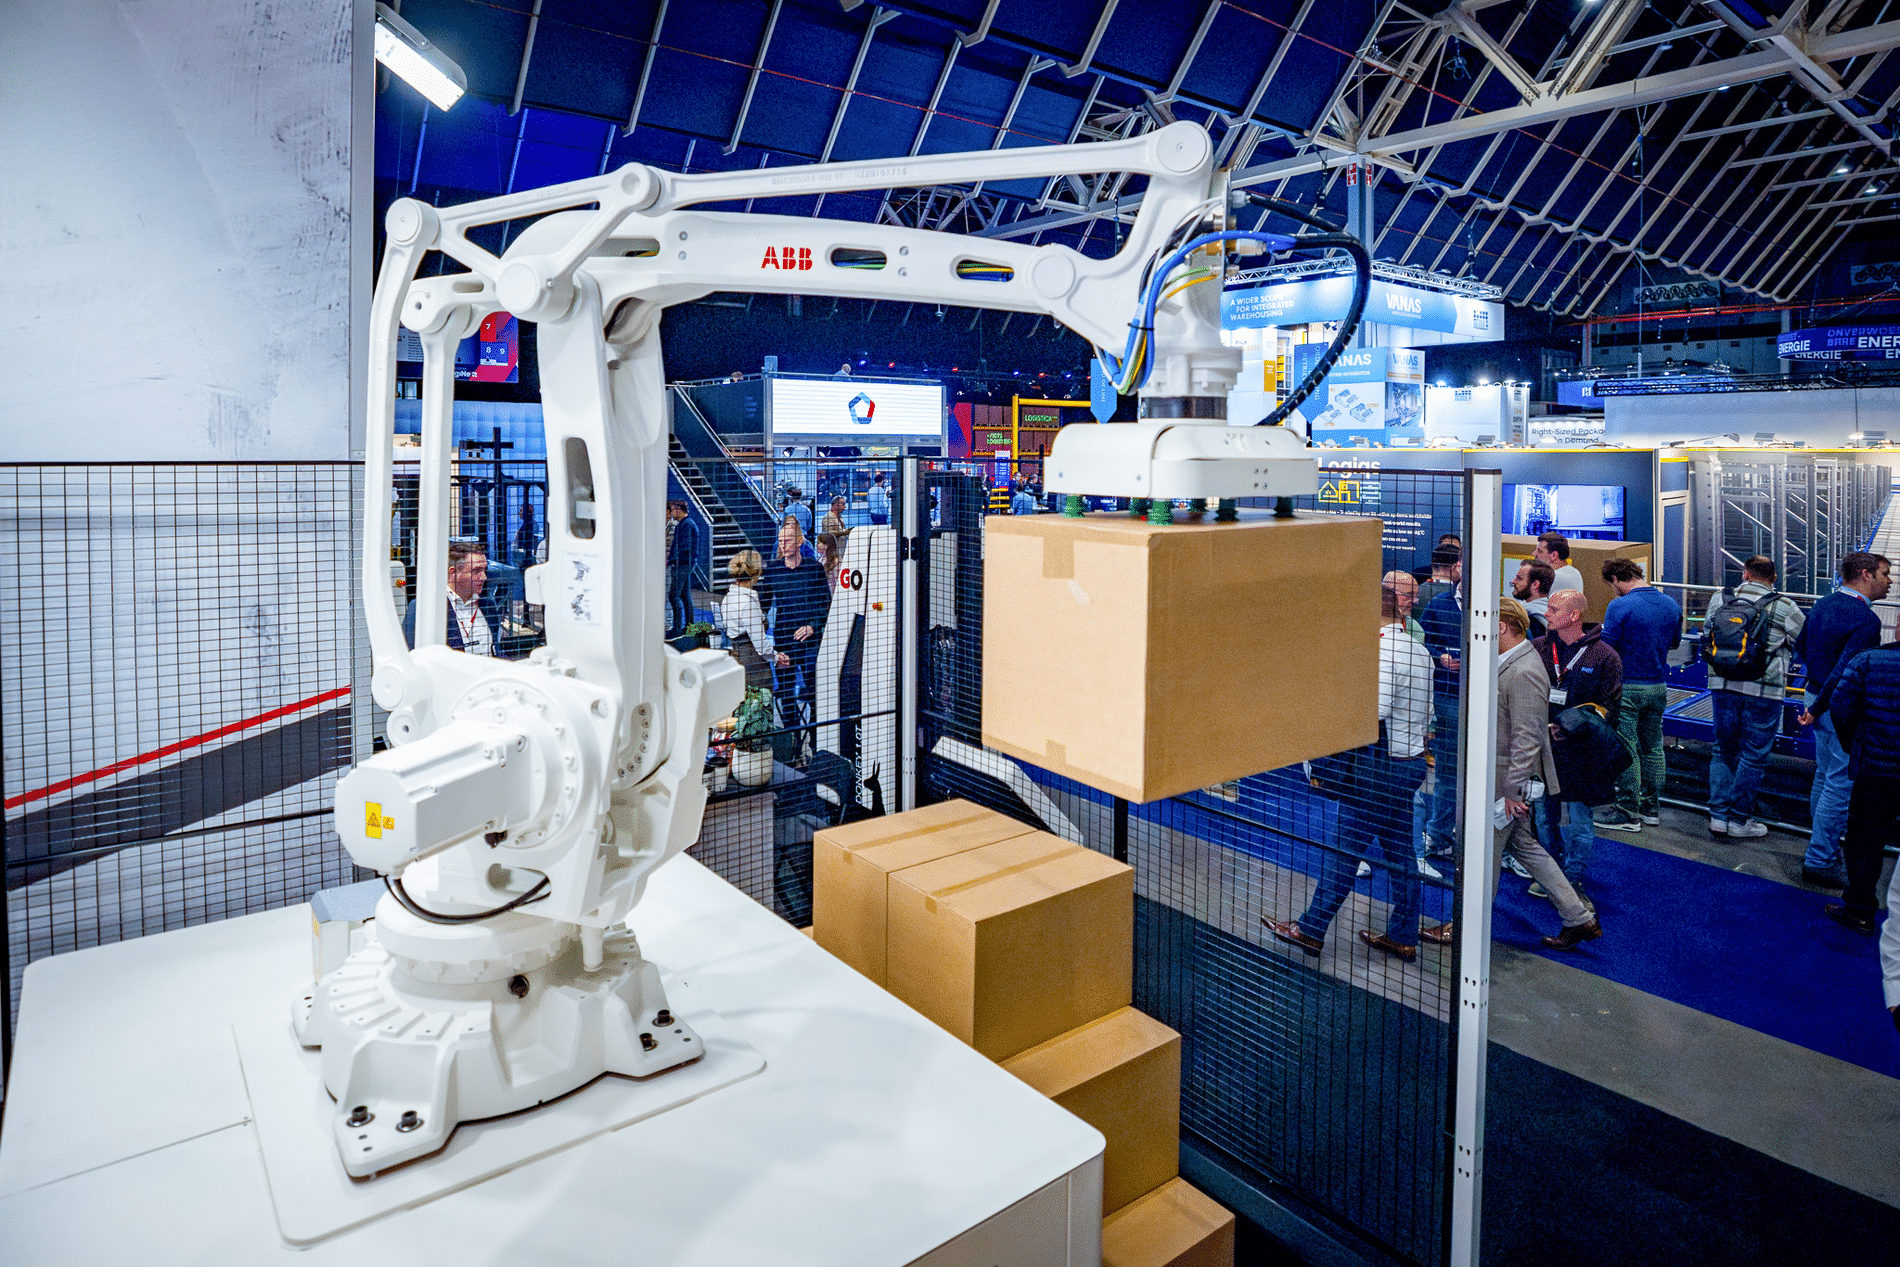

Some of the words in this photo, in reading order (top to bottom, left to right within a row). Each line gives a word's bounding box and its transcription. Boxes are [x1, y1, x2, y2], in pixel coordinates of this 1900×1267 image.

[761, 245, 813, 271] ABB
[1236, 305, 1250, 313] FOR
[1251, 300, 1295, 311] INTEGRATED
[1237, 296, 1259, 305] WIDER
[1386, 293, 1422, 314] VANAS
[1230, 309, 1284, 321] WAREHOUSING
[1778, 340, 1811, 354] ENERGIE
[1857, 335, 1900, 348] ENER
[1332, 353, 1372, 367] ANAS
[1531, 428, 1576, 437] Right-Sized
[1317, 456, 1381, 479] Logiqs
[840, 568, 863, 590] GO
